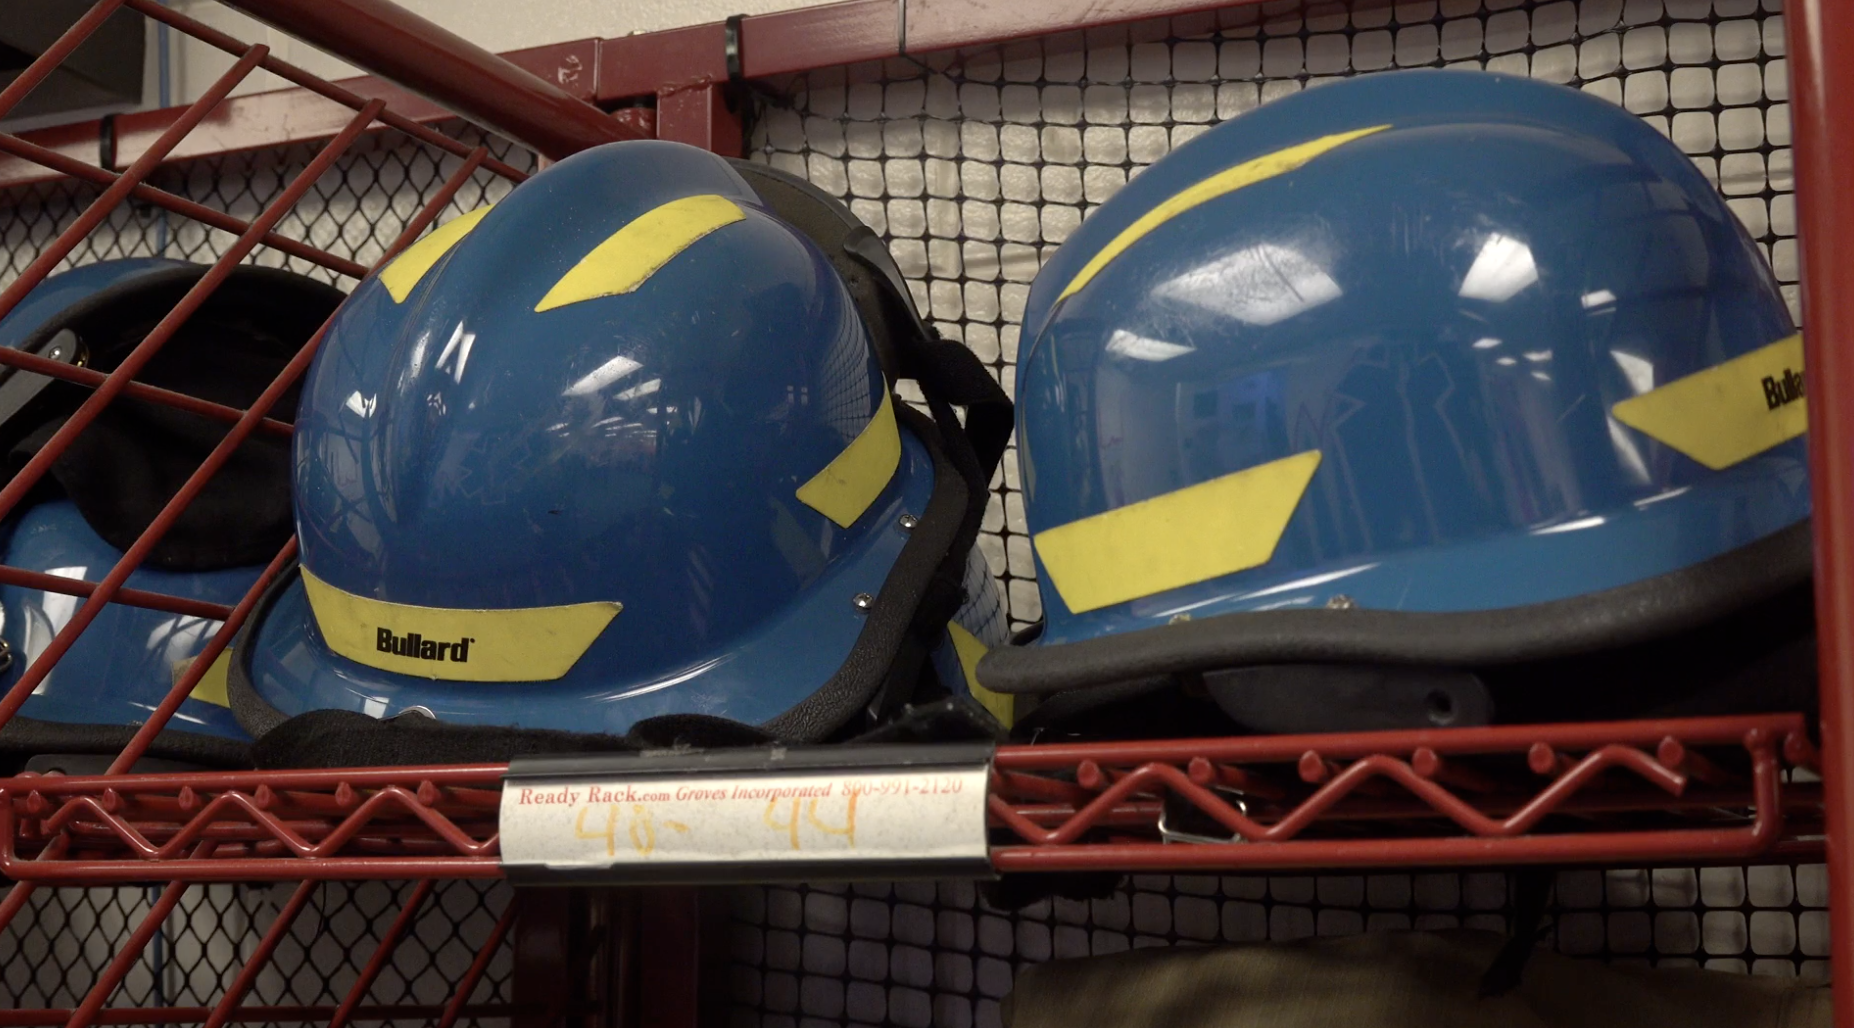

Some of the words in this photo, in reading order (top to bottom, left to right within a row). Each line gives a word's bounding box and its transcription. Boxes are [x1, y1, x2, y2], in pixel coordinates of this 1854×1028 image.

[1761, 367, 1805, 411] Bulla
[376, 627, 470, 662] Bullard
[518, 785, 580, 807] Ready
[675, 785, 728, 801] Groves
[731, 781, 833, 802] Incorporated
[841, 775, 963, 797] 800-991-2120
